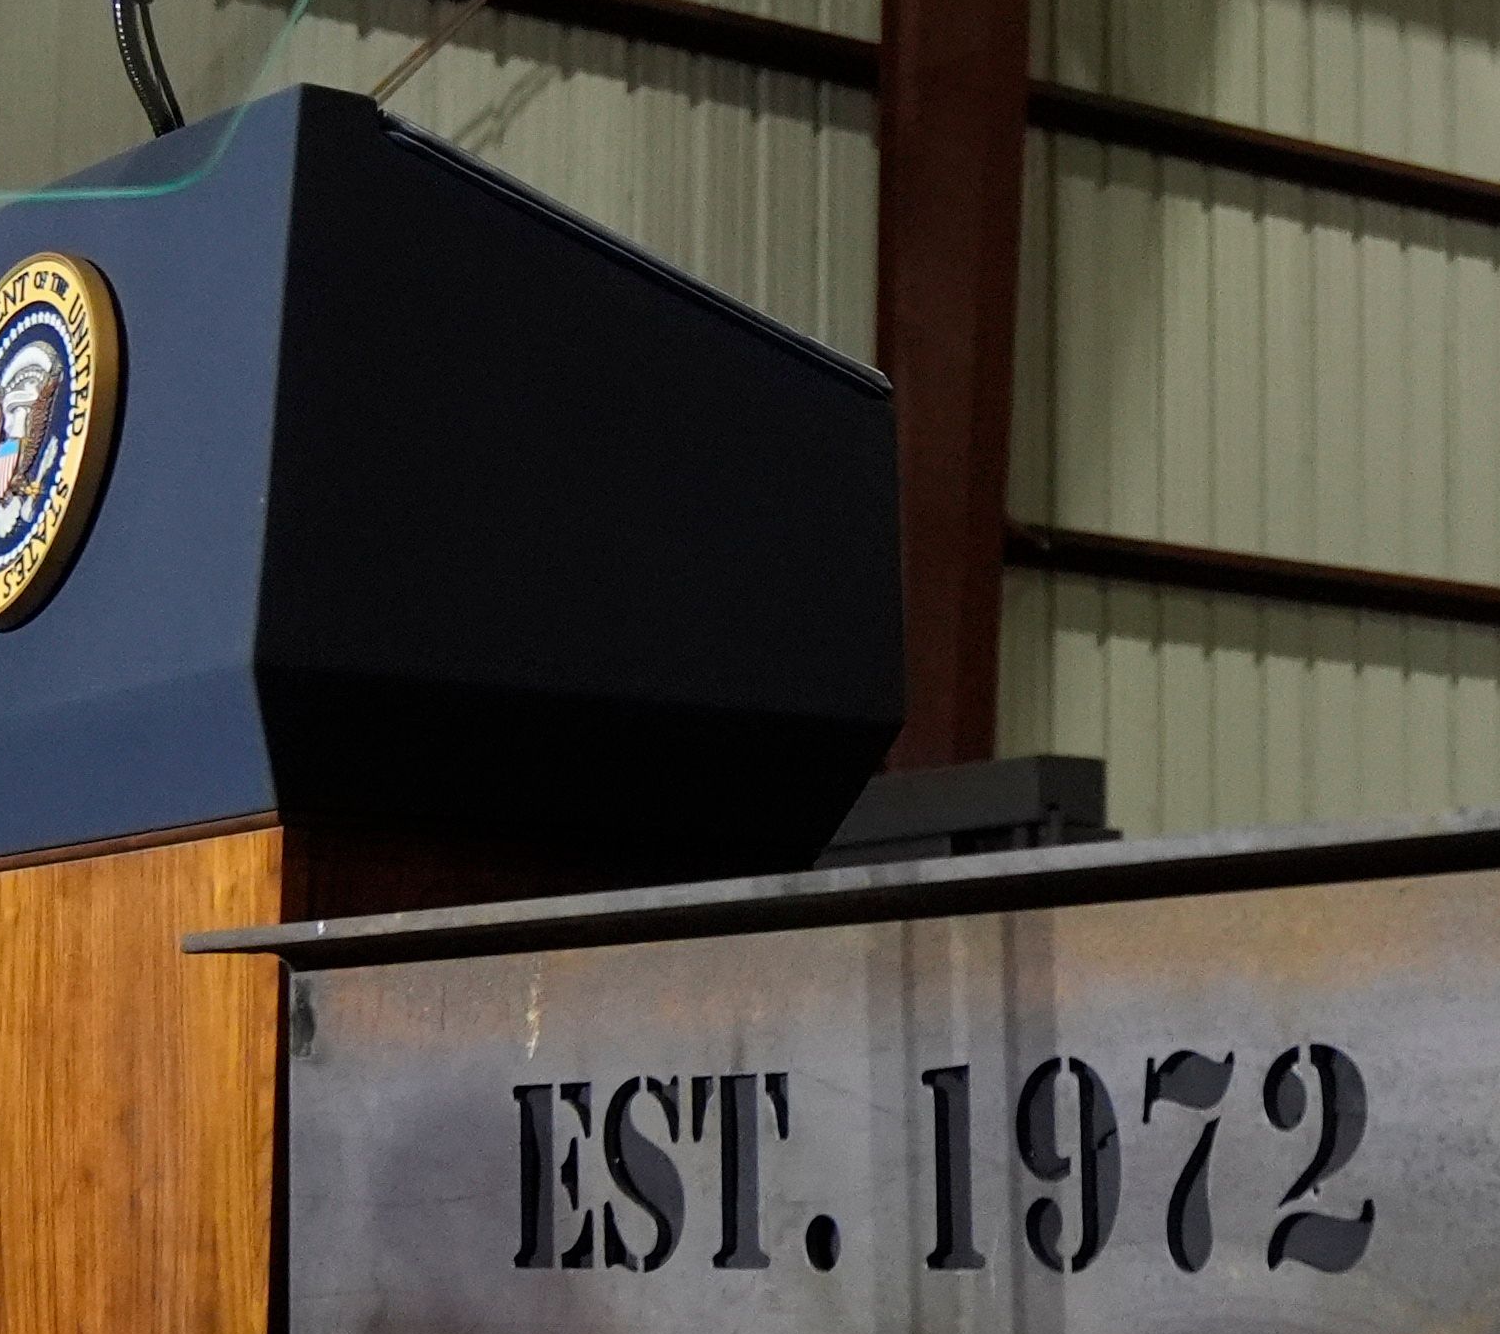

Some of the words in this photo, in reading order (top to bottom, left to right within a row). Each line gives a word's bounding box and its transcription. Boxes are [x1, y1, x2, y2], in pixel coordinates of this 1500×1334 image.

[50, 271, 69, 301] THE
[68, 293, 92, 437] UNITED
[1, 476, 70, 599] STATES
[512, 1069, 843, 1273] EST.
[921, 1040, 1376, 1274] 1972
